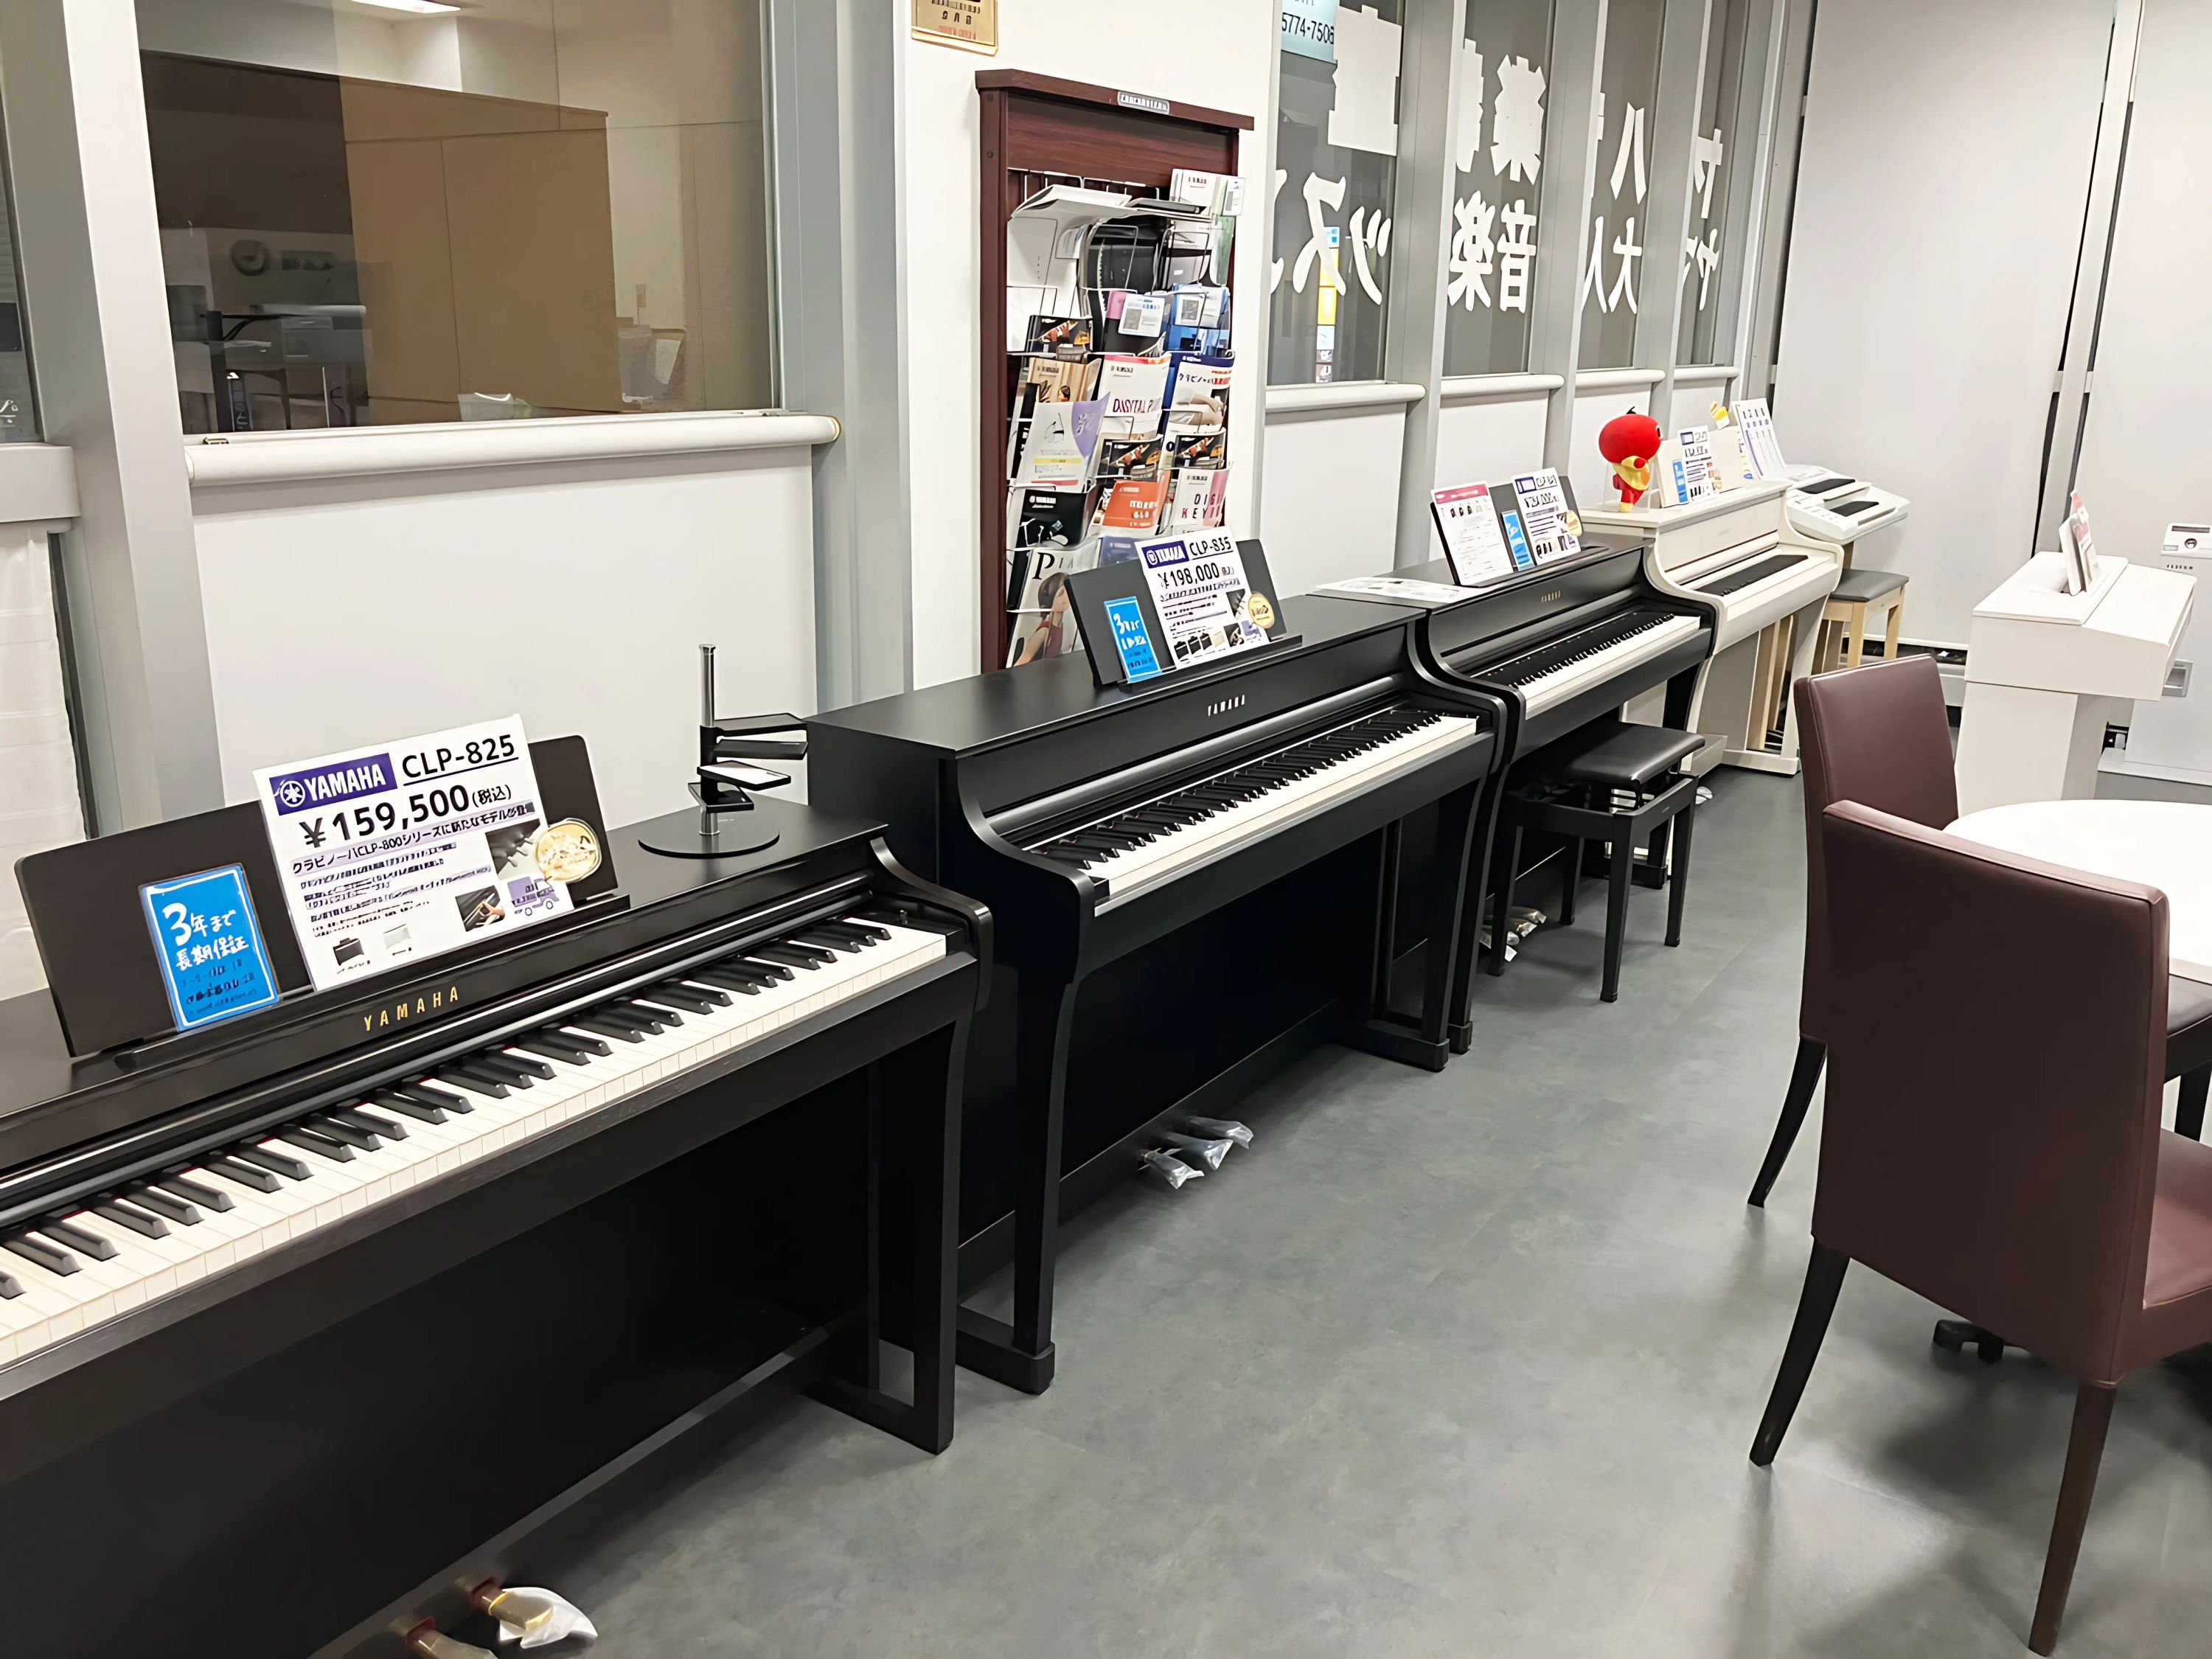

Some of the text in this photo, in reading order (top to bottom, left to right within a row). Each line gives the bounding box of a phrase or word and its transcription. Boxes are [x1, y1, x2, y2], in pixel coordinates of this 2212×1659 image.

[305, 734, 515, 801] YAMAHA CLP-825
[299, 785, 469, 848] ¥159,500
[364, 986, 459, 1032] YAMAHA
